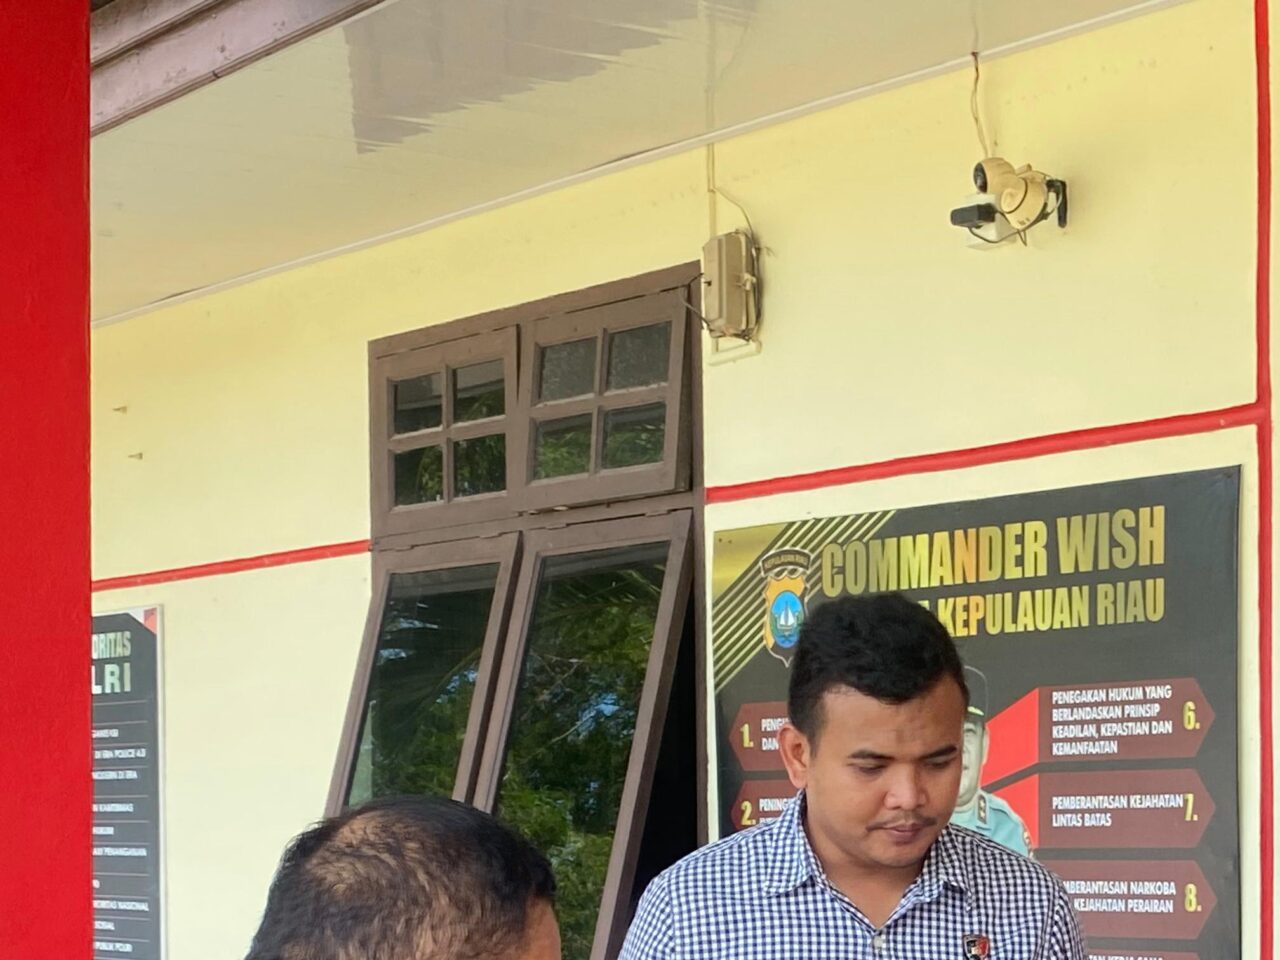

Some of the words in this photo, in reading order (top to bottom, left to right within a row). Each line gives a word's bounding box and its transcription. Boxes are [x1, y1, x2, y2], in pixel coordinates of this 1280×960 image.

[822, 521, 1047, 598] COMMANDER
[1056, 505, 1165, 574] WISH
[937, 586, 1089, 637] KEPULAUAN
[1096, 578, 1165, 625] RIAU
[1052, 689, 1106, 704] PENEGAKAN
[1108, 687, 1144, 701] HUKUM
[1145, 685, 1172, 698] YANG
[1052, 706, 1122, 721] BERLANDASKAN
[1124, 703, 1160, 718] PRINSIP
[1183, 701, 1200, 730] 6.
[1052, 724, 1098, 739] KEADILAN,
[1100, 722, 1149, 736] KEPASTIAN
[1152, 721, 1172, 734] DAN
[1052, 740, 1118, 755] KEMANFAATAN
[1052, 795, 1127, 809] PEMBERANTASAN
[1129, 794, 1183, 808] KEJAHATAN
[1184, 793, 1198, 821] 7.
[1052, 813, 1082, 827] LINTAS
[1084, 813, 1112, 827] BATAS
[1130, 882, 1176, 895] NARKOBA
[1184, 883, 1202, 912] 8.
[1127, 900, 1173, 913] PERAIRAN
